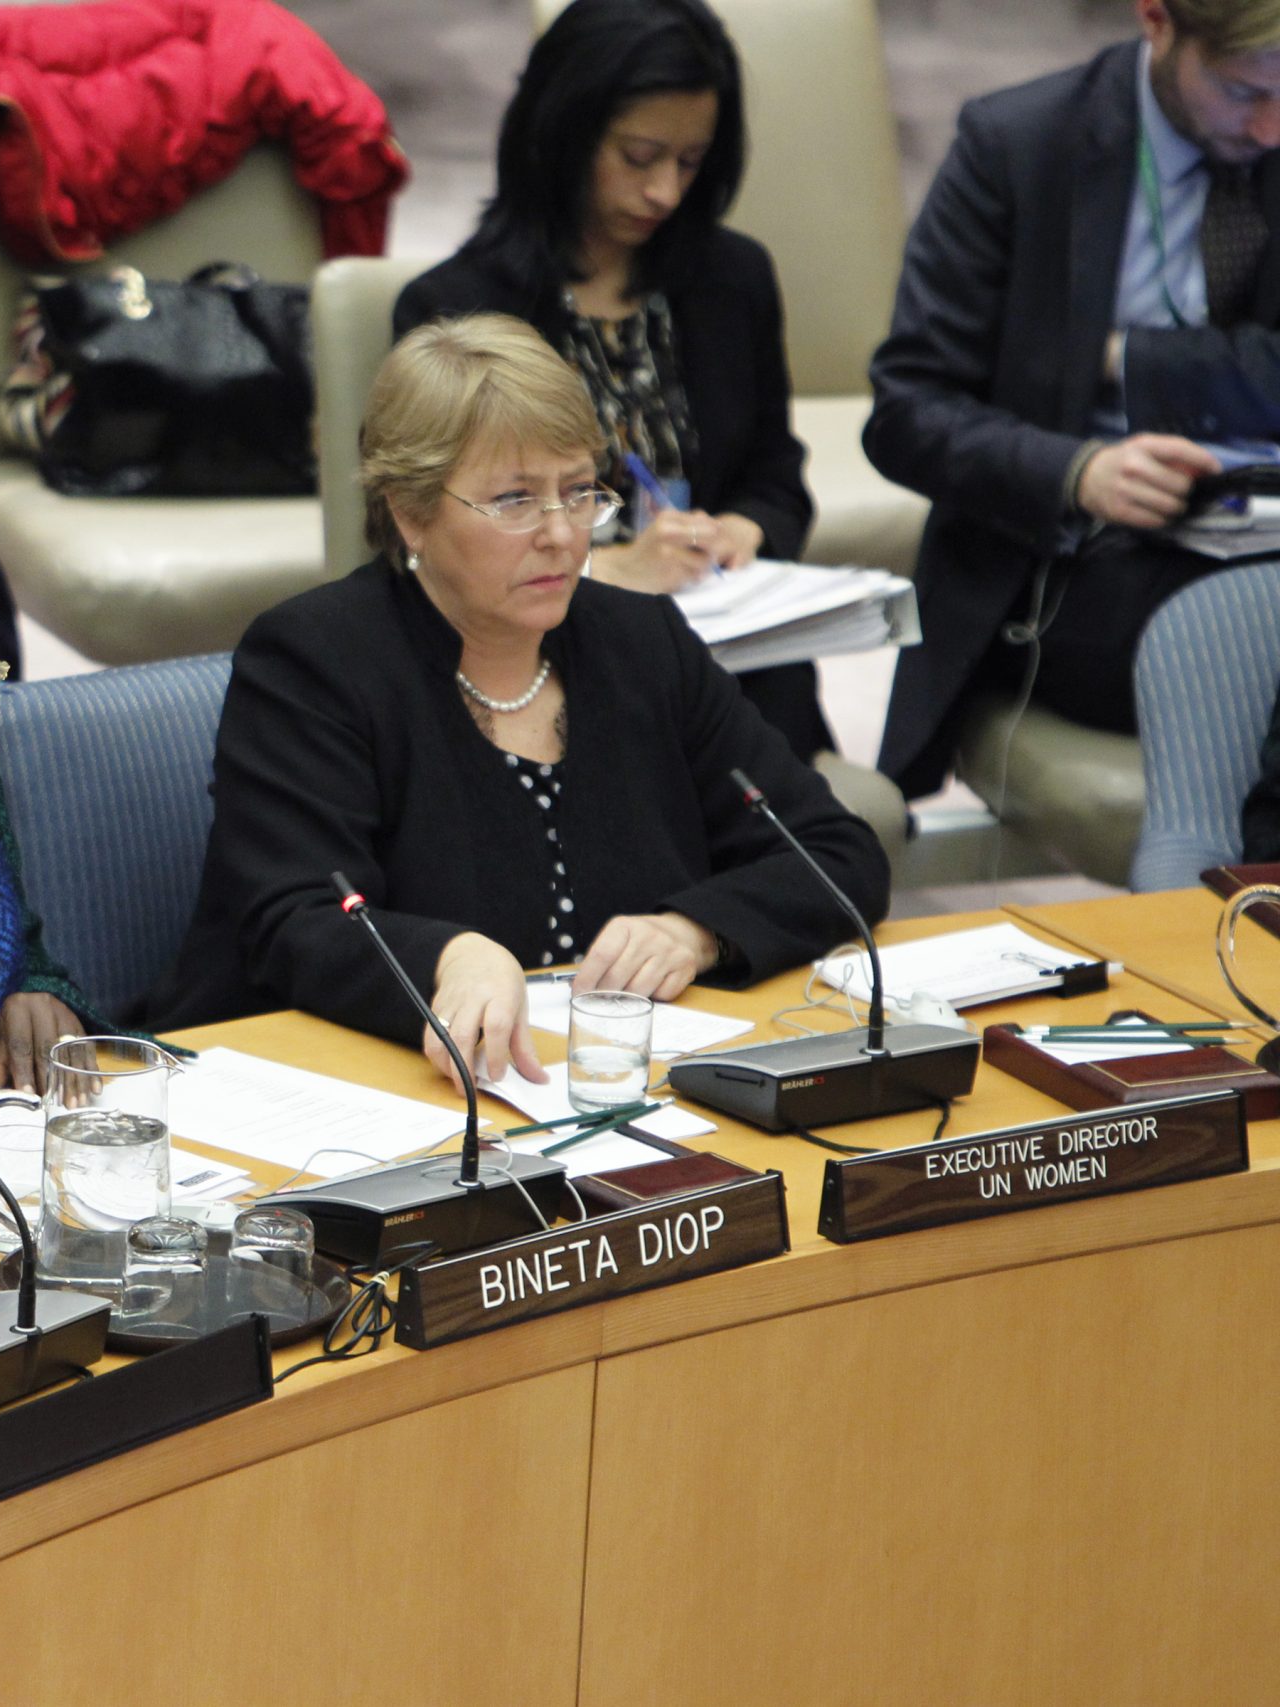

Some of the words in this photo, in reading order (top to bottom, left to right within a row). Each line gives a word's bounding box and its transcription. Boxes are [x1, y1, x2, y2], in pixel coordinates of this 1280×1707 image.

[925, 1135, 1045, 1179] EXECUTIVE
[1057, 1116, 1158, 1156] DIRECTOR
[979, 1172, 1012, 1199] UN
[1024, 1155, 1107, 1191] WOMEN
[480, 1234, 619, 1308] BINETA
[638, 1205, 724, 1266] DIOP
